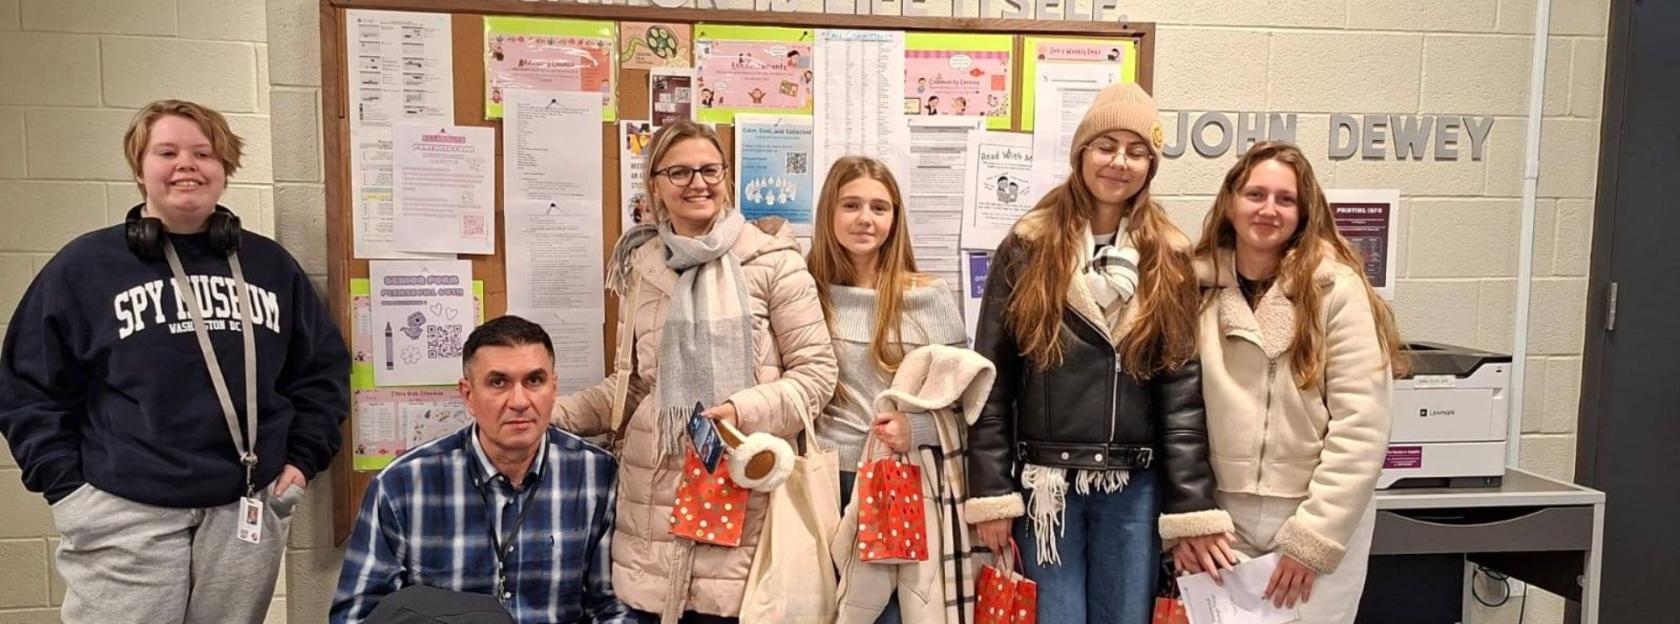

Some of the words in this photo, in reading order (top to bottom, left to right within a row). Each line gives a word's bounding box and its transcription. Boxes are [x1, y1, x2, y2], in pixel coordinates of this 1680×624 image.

[981, 152, 999, 160] Read
[1002, 148, 1022, 160] With
[1162, 111, 1297, 158] JOHN
[1329, 114, 1495, 161] DEWEY
[114, 279, 166, 339] SPY
